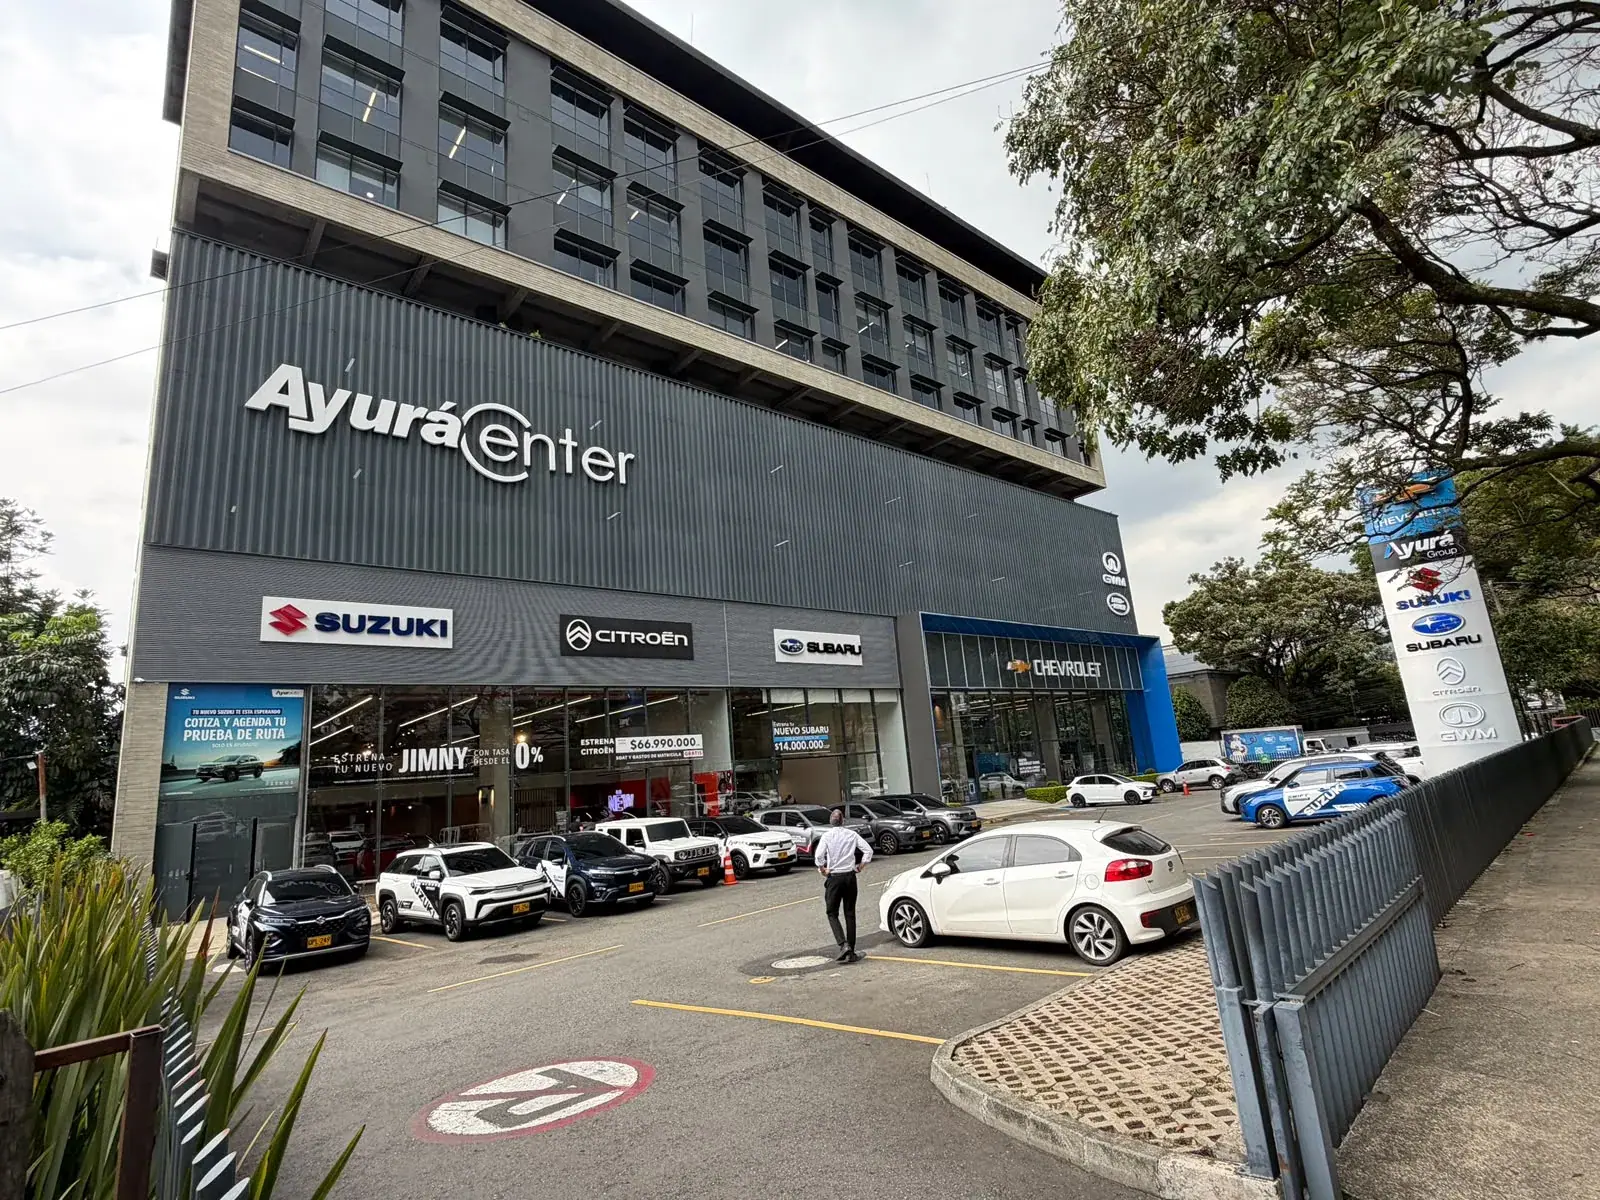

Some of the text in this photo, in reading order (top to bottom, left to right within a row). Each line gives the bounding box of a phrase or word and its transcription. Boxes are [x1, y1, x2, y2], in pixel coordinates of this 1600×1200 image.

[244, 363, 460, 449] Ayurá
[1384, 530, 1454, 560] Ayurá
[1427, 547, 1458, 559] Group
[1102, 574, 1126, 587] GWM
[1396, 589, 1471, 611] SUZUKI
[314, 612, 448, 638] SUZUKI
[806, 641, 863, 656] SUBARU
[1406, 634, 1483, 652] SUBARU
[1032, 659, 1102, 678] CHEVROLET
[184, 716, 286, 728] COTIZA Y AGENDA TU
[183, 727, 286, 741] PRUEBA DE RUTA
[773, 725, 829, 735] NUEVO SUBARU
[1441, 727, 1498, 742] GWM
[580, 738, 615, 746] ESTRENA
[630, 737, 696, 751] $66.990.000
[774, 740, 824, 751] $14.000.000
[334, 753, 385, 763] ESTRENA
[473, 748, 510, 757] CON TASA
[515, 742, 544, 769] 0%
[580, 747, 614, 756] CITROËN
[398, 747, 468, 773] JIMNY
[473, 757, 510, 766] DESDE EL
[334, 763, 393, 774] TU NUEVO
[1303, 782, 1347, 816] SUZUKI
[410, 878, 436, 918] SUZUKI
